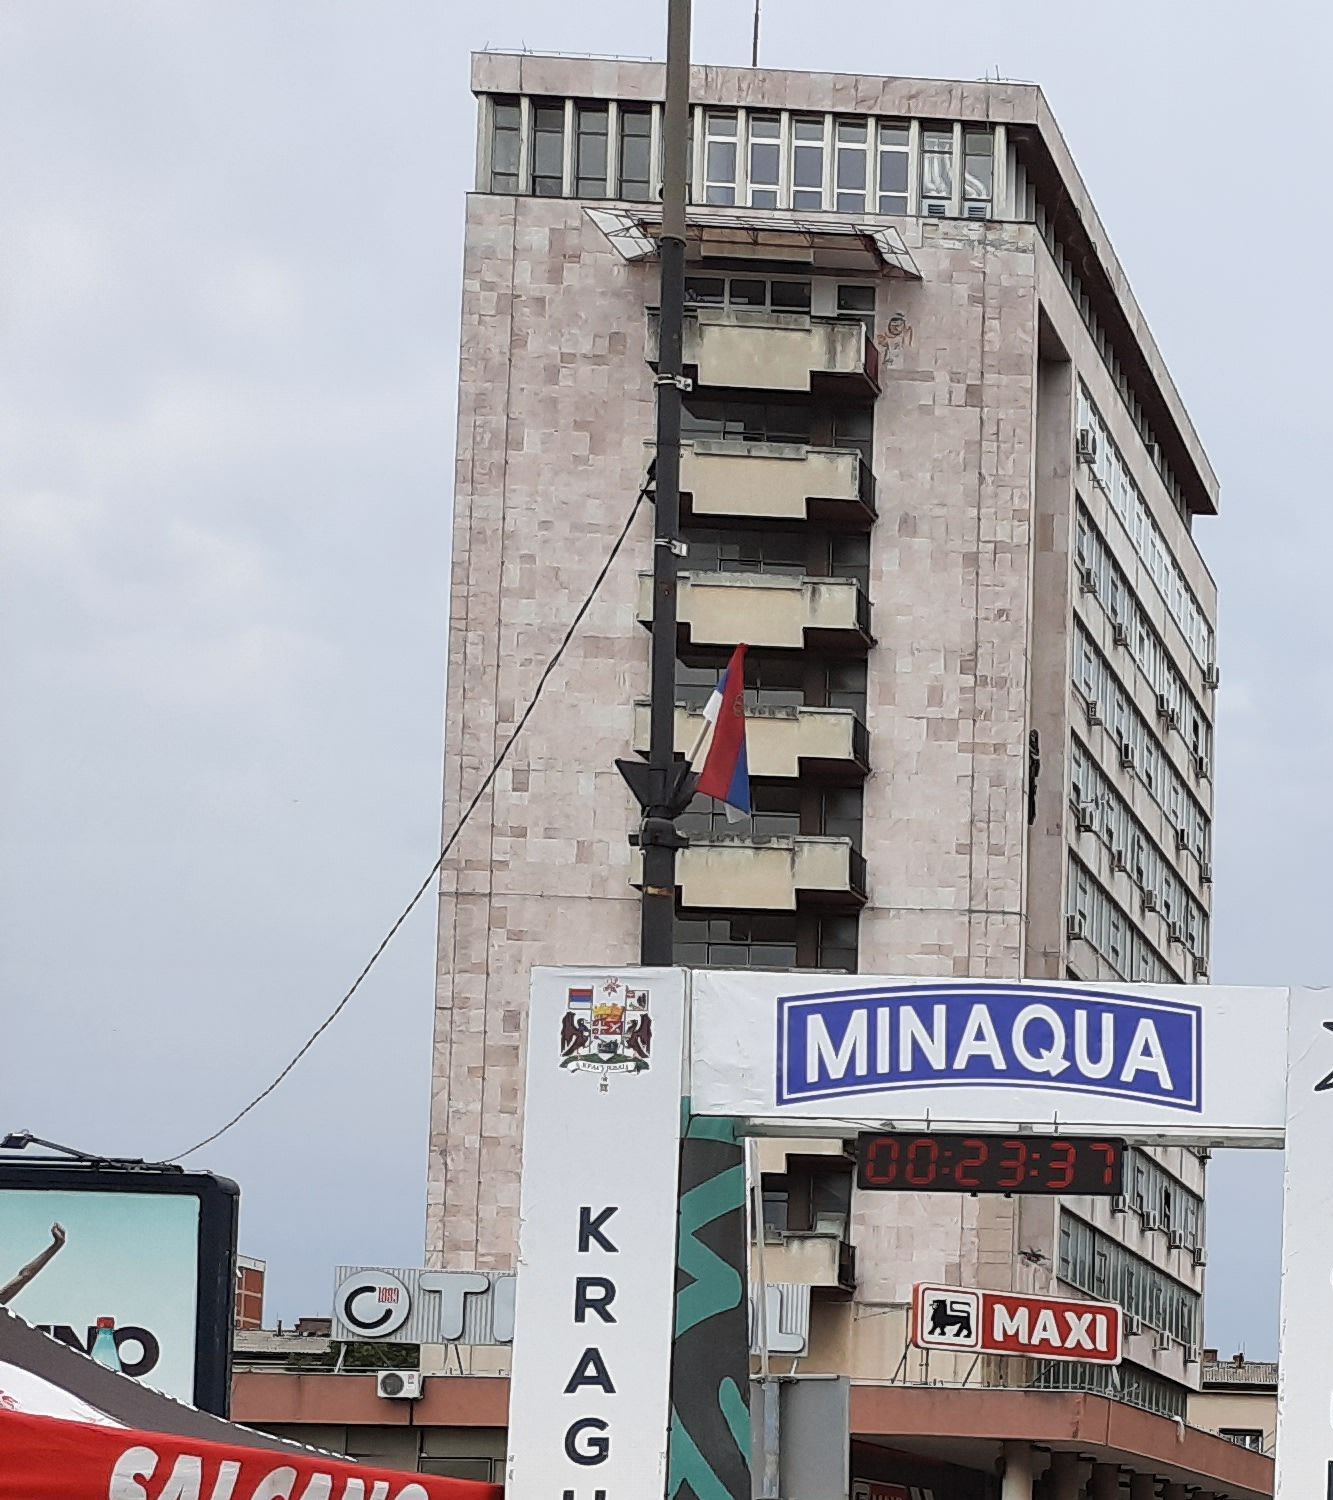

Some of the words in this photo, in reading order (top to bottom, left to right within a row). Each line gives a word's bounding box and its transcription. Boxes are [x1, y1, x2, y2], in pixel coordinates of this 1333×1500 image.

[805, 1003, 1174, 1091] MINAQUA
[866, 1139, 1115, 1187] 00:23:37
[992, 1303, 1110, 1353] MAXI
